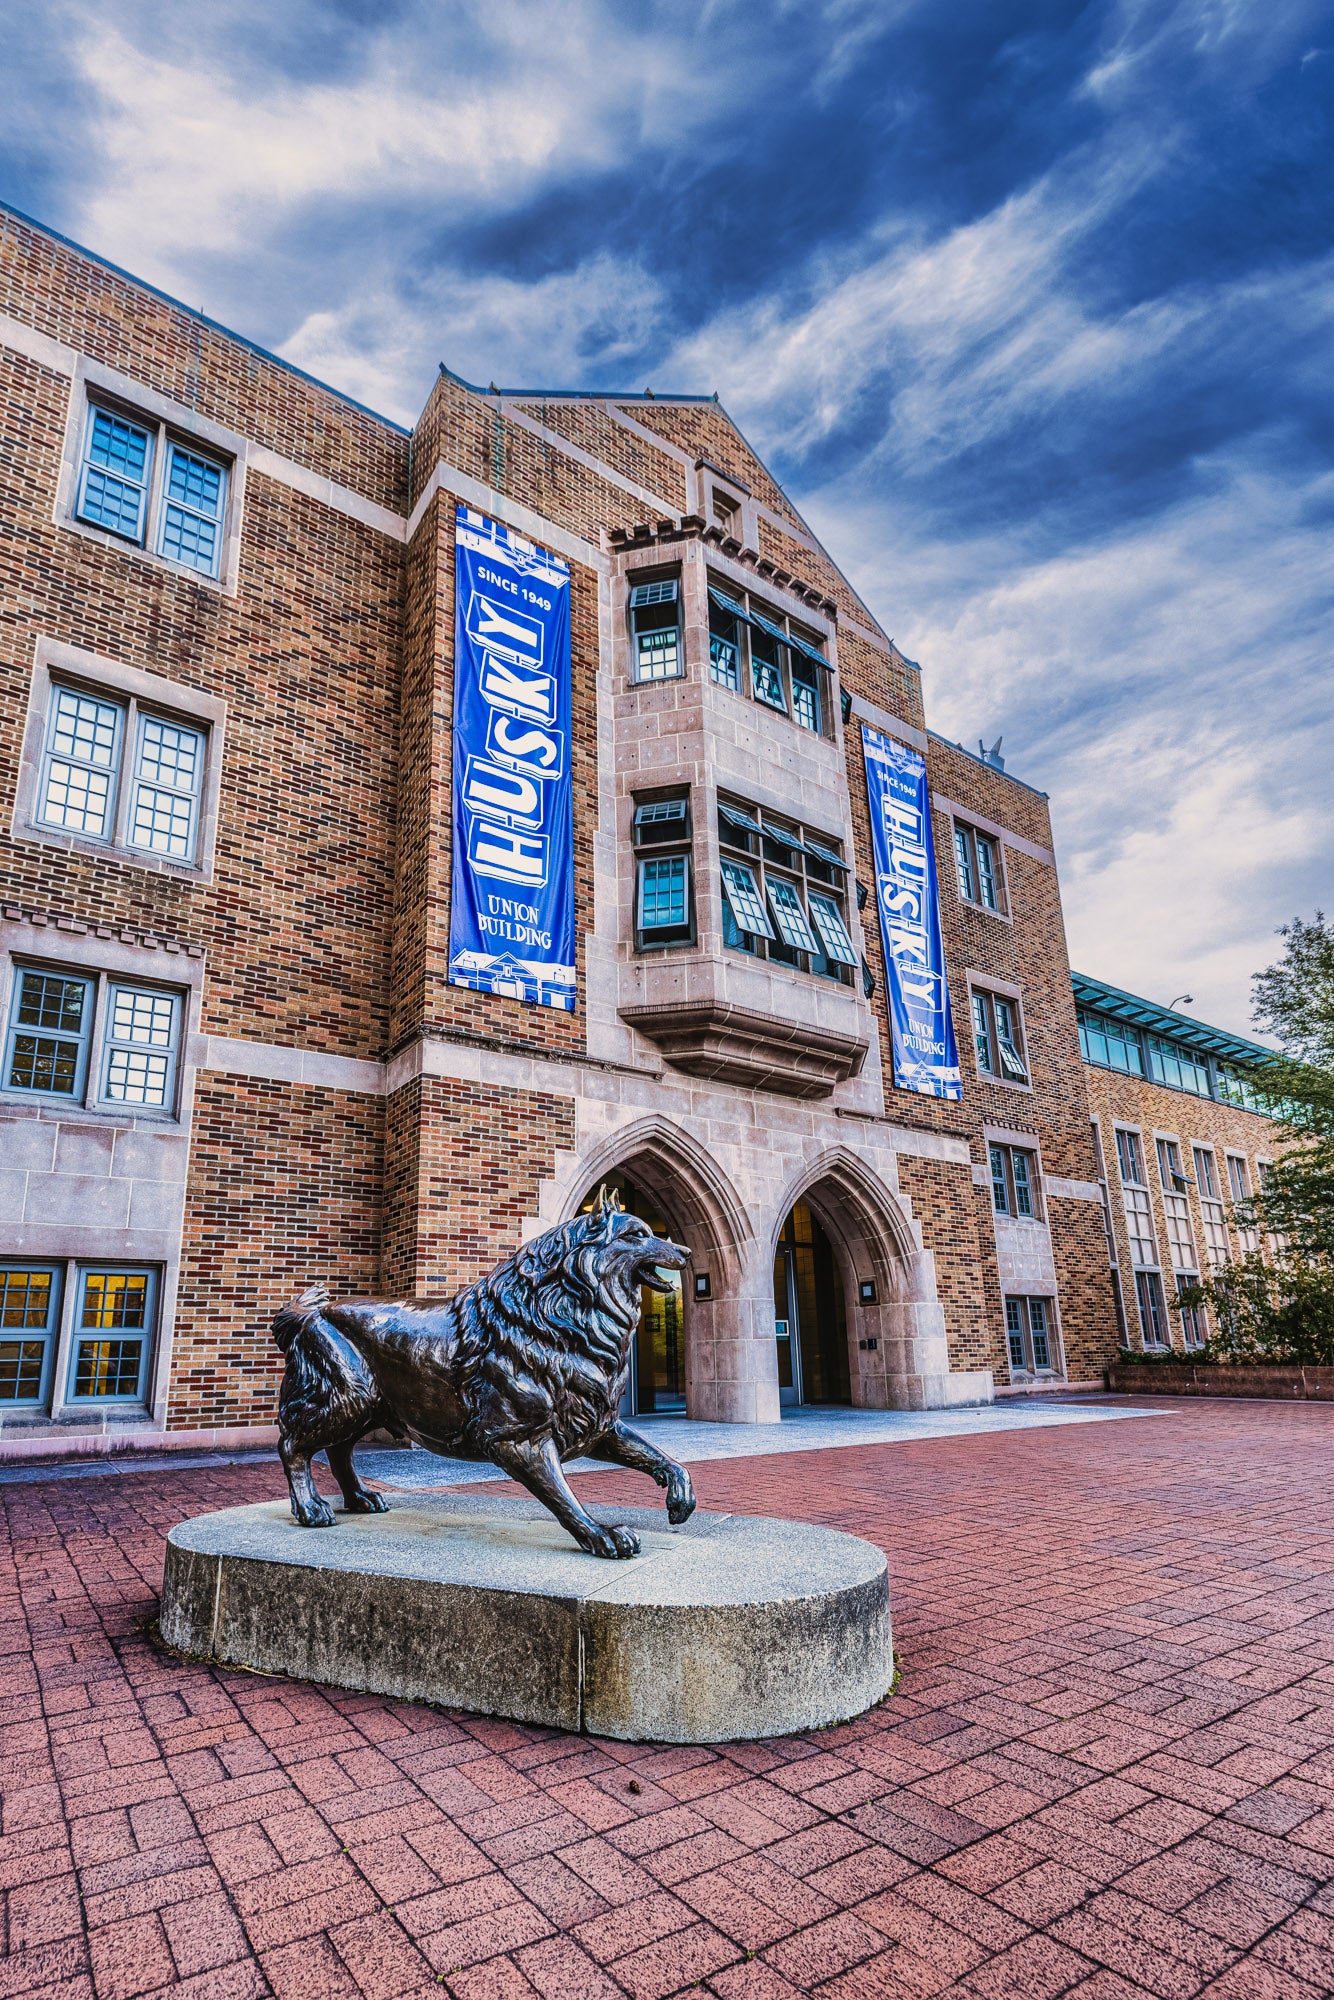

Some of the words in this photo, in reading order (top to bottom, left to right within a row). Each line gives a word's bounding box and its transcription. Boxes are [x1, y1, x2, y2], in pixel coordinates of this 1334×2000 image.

[477, 566, 518, 595] SINCE
[521, 588, 552, 612] 1949
[466, 594, 561, 880] HUSKY
[876, 769, 899, 789] SINCE
[899, 782, 917, 798] 1949
[487, 894, 539, 925] UNION
[881, 798, 940, 1011] HUSKY
[477, 912, 552, 950] BUILDING
[902, 1033, 945, 1056] BUILDING
[907, 1018, 934, 1039] UNION
